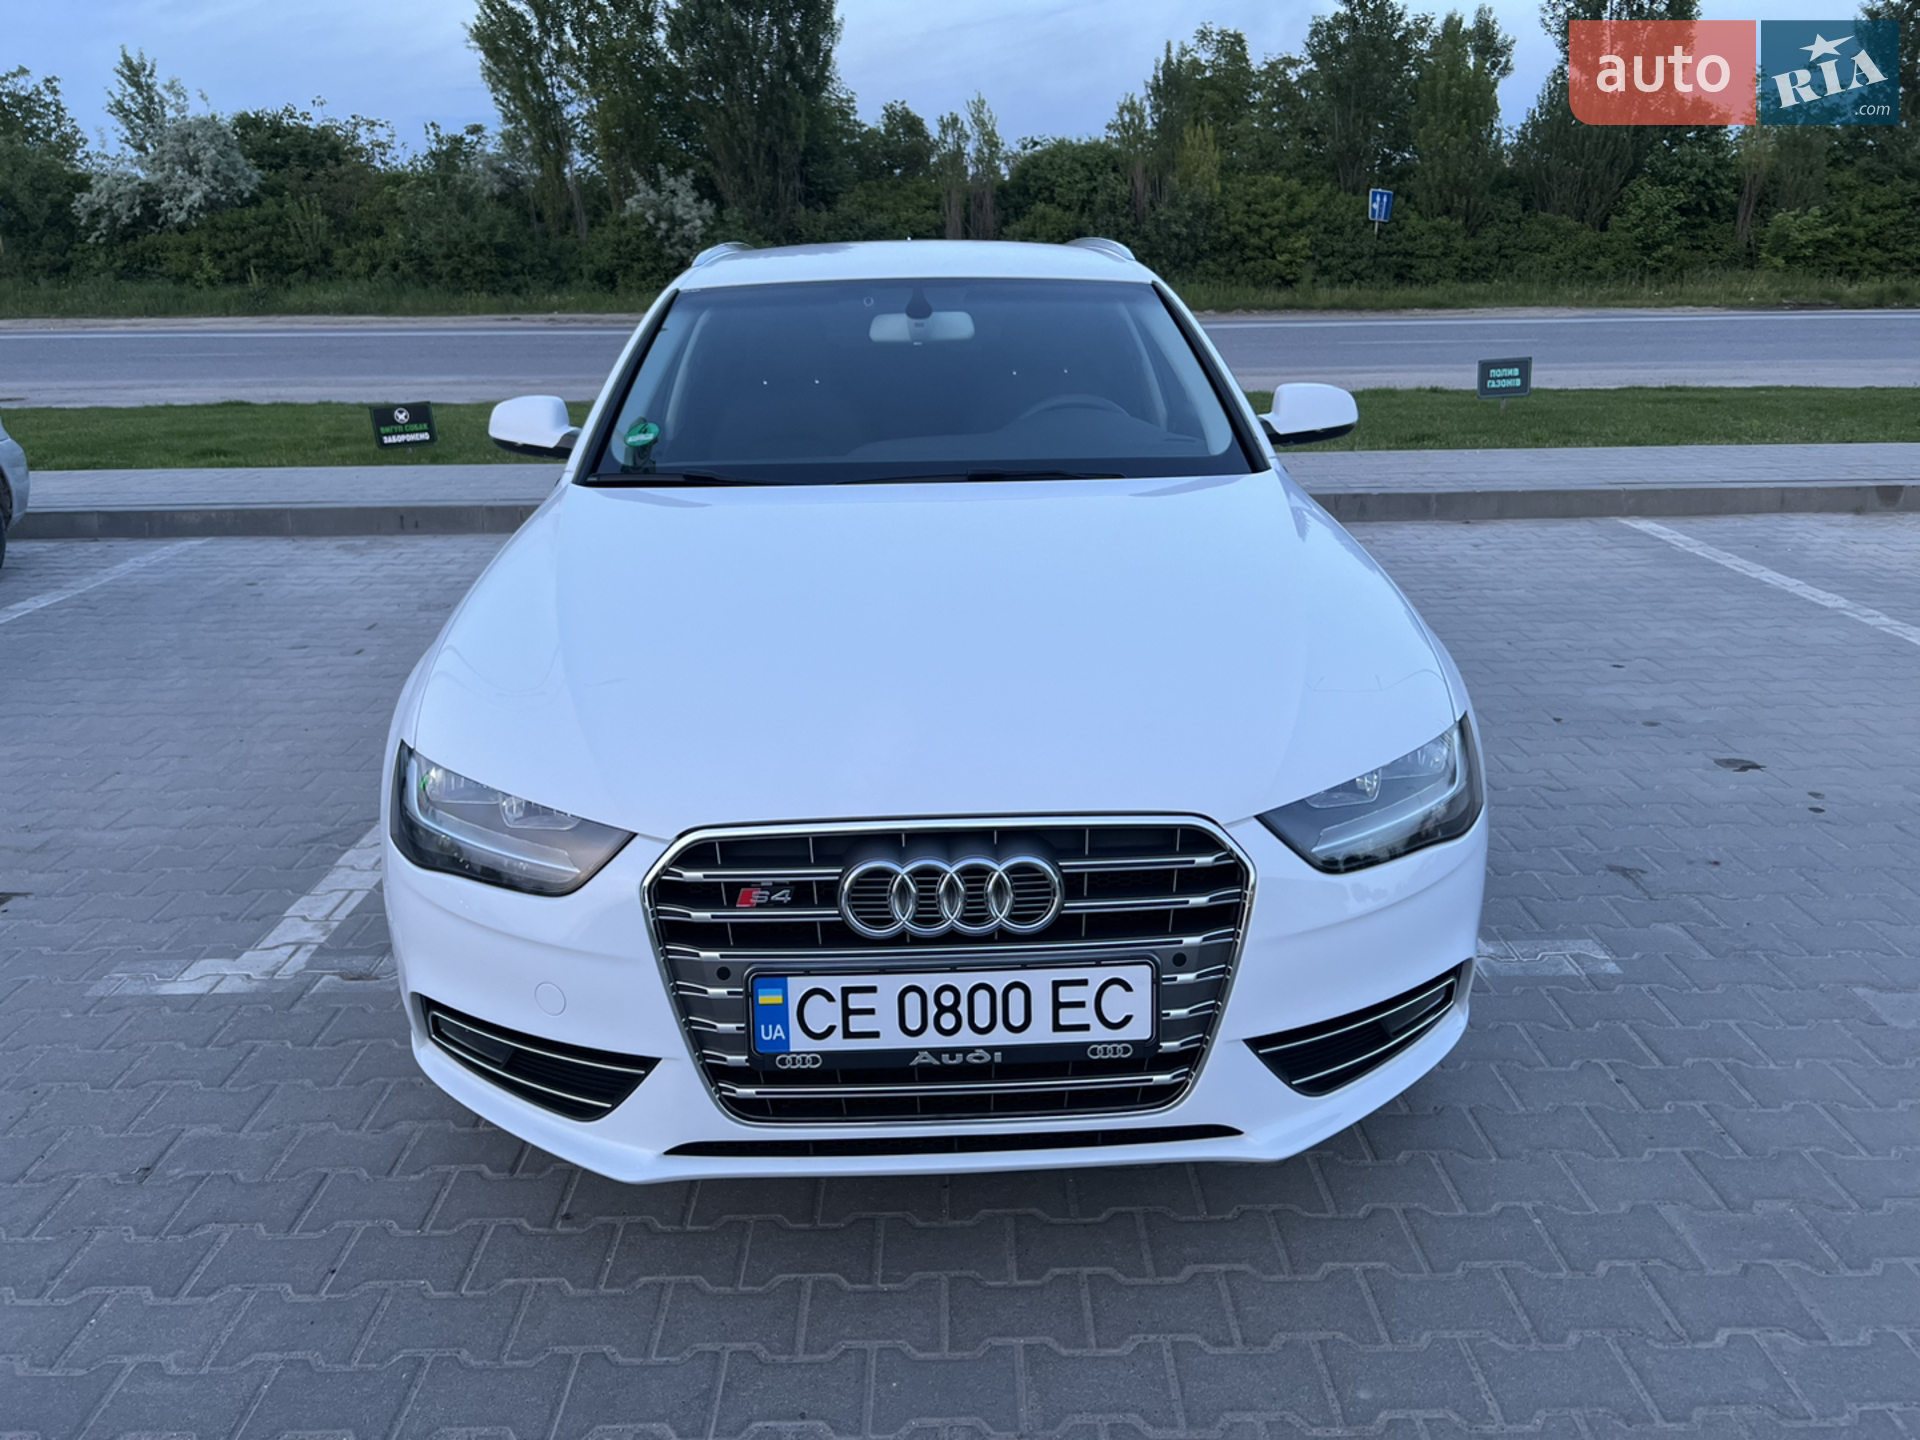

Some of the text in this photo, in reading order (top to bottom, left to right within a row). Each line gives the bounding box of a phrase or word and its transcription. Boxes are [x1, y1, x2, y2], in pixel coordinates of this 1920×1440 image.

[1489, 367, 1520, 378] ПОЛИВ
[1486, 378, 1521, 389] ГАЗОНІВ
[382, 431, 430, 444] ЗАБОРОНЕНО
[750, 888, 792, 904] S4
[796, 976, 1135, 1042] CE 0800 EC
[760, 1024, 786, 1041] UA
[909, 1050, 1003, 1066] Audi
